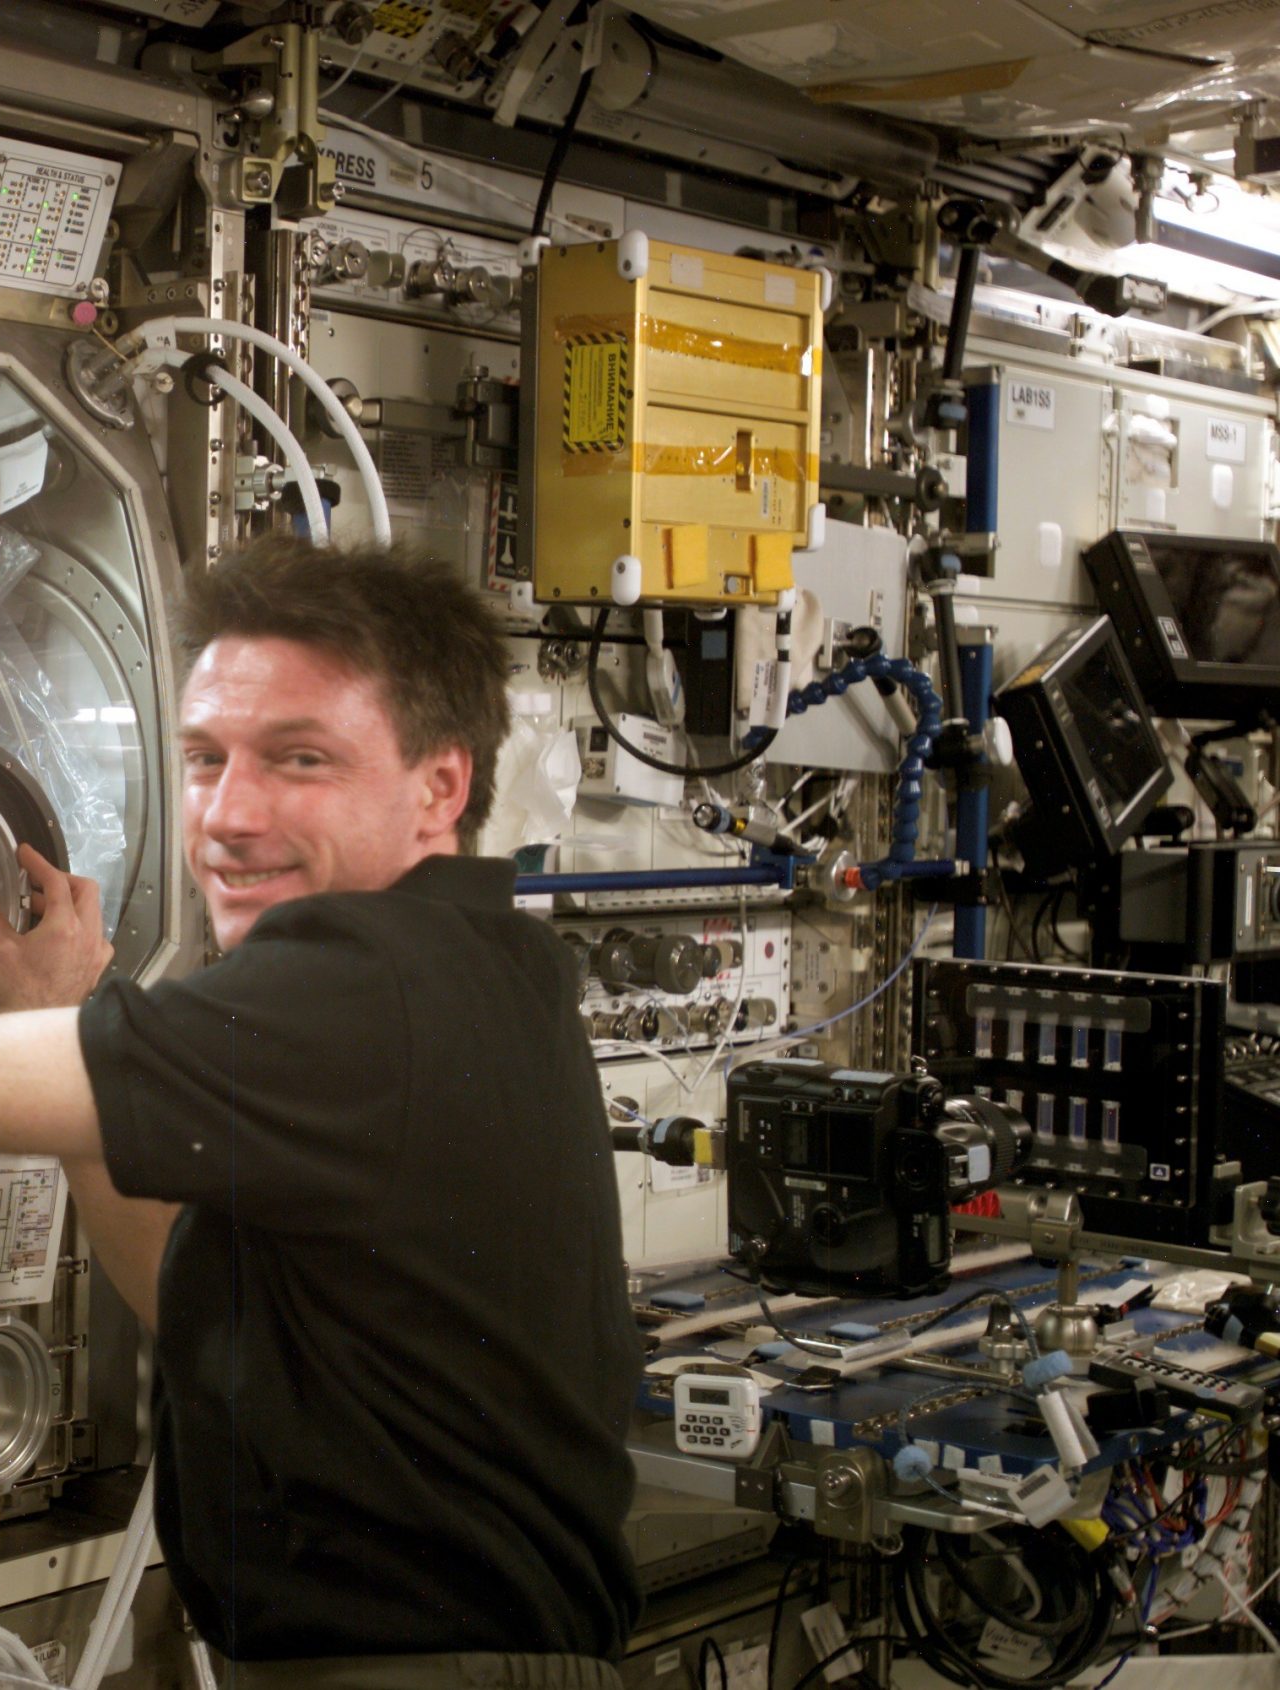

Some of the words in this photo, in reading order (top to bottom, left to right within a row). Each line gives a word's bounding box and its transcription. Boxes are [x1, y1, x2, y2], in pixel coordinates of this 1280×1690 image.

[35, 167, 60, 178] HEALTH
[64, 172, 86, 183] STATUS
[421, 161, 432, 190] 5
[606, 353, 617, 433] ВНИМАНИЕ
